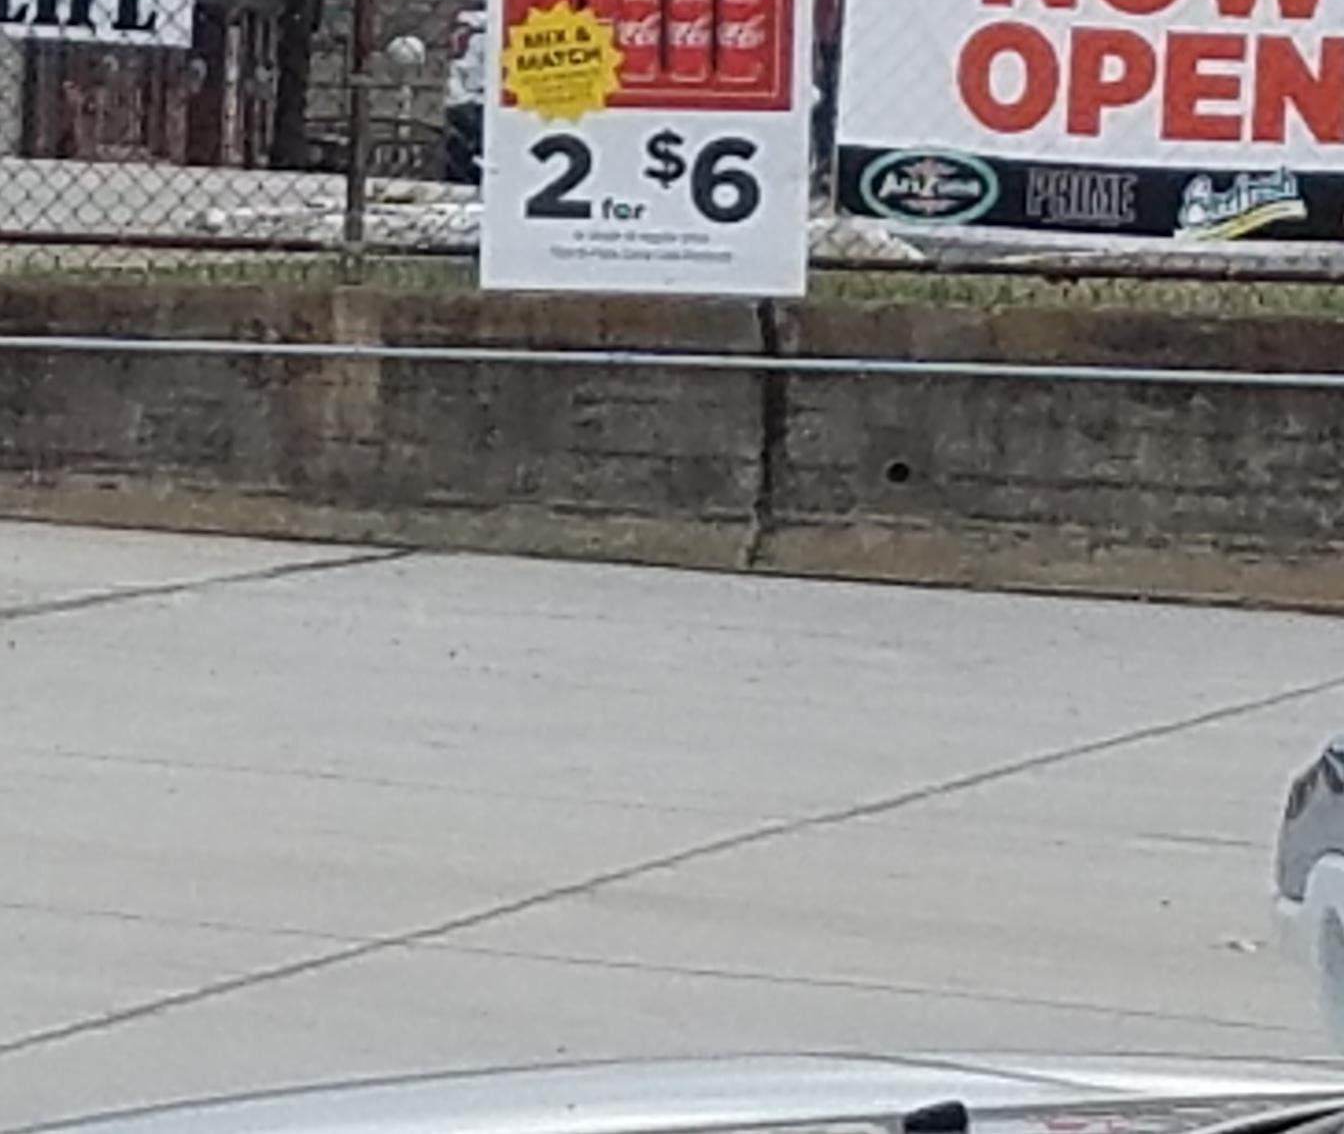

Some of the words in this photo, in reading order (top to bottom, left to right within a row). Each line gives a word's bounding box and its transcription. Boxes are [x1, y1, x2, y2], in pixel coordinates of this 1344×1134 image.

[517, 47, 602, 72] MATCH
[523, 29, 566, 49] MIX
[956, 20, 1344, 145] OPEN
[525, 132, 593, 220] 2
[601, 195, 648, 222] for
